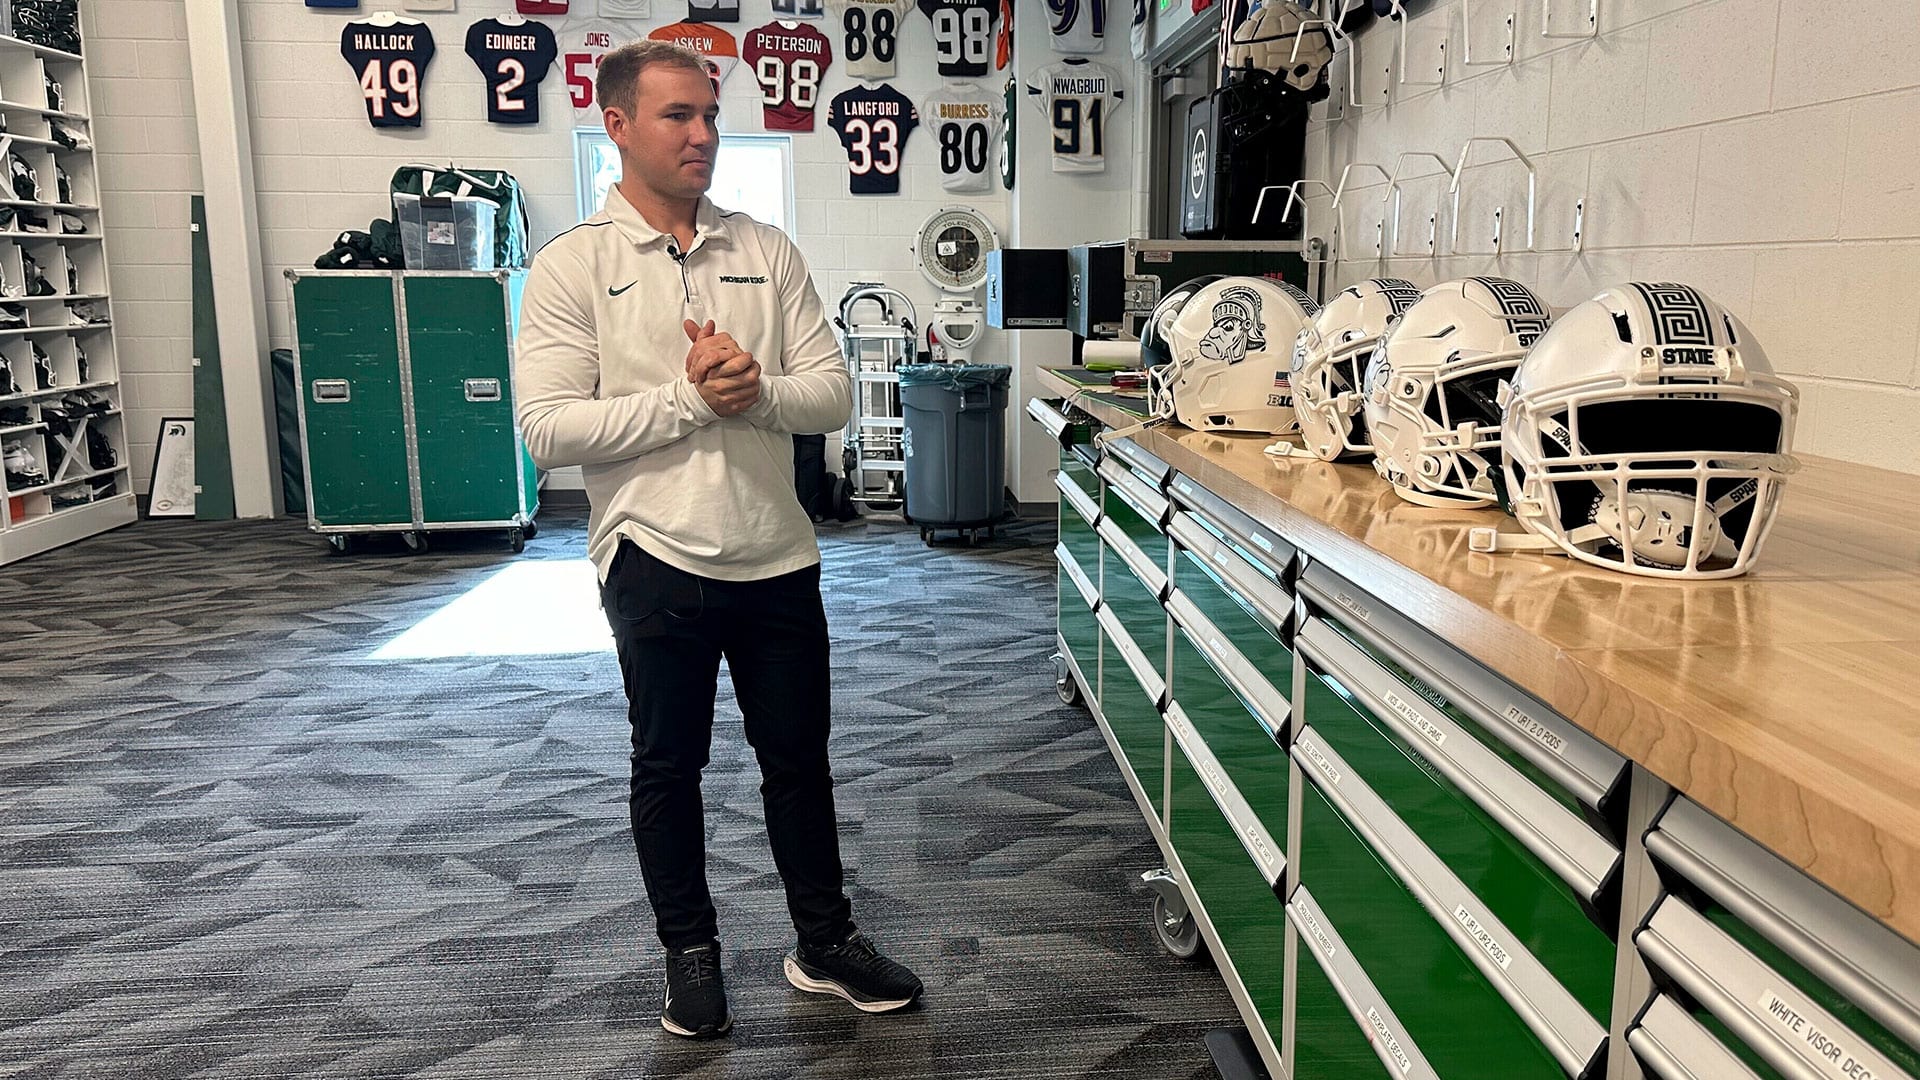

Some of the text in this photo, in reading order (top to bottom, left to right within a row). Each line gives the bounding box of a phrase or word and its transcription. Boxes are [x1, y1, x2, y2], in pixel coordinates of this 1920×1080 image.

[354, 33, 414, 51] HALLOCK
[485, 33, 536, 51] EDINGER
[584, 32, 610, 48] JONES
[674, 37, 713, 51] ASKEW
[757, 33, 822, 54] PETERSON
[844, 7, 896, 62] 88
[932, 8, 990, 64] 98
[360, 58, 420, 118] 49
[495, 57, 526, 111] 2
[756, 55, 819, 109] 98
[843, 101, 900, 117] LANGFORD
[939, 103, 989, 119] BURRESS
[1052, 97, 1103, 156] 91
[845, 118, 899, 176] 33
[939, 122, 988, 174] 80
[943, 221, 972, 229] TOLEDO
[1662, 347, 1715, 366] STATE
[1407, 708, 1420, 723] PADS
[1417, 719, 1429, 730] AND
[1508, 707, 1519, 719] F7
[1541, 731, 1562, 749] PODS
[1458, 909, 1468, 920] F7
[1488, 943, 1507, 963] PODS
[1370, 1011, 1408, 1068] BACKPLATE DECALS
[1769, 997, 1876, 1080] WHITE VISOR DEC
